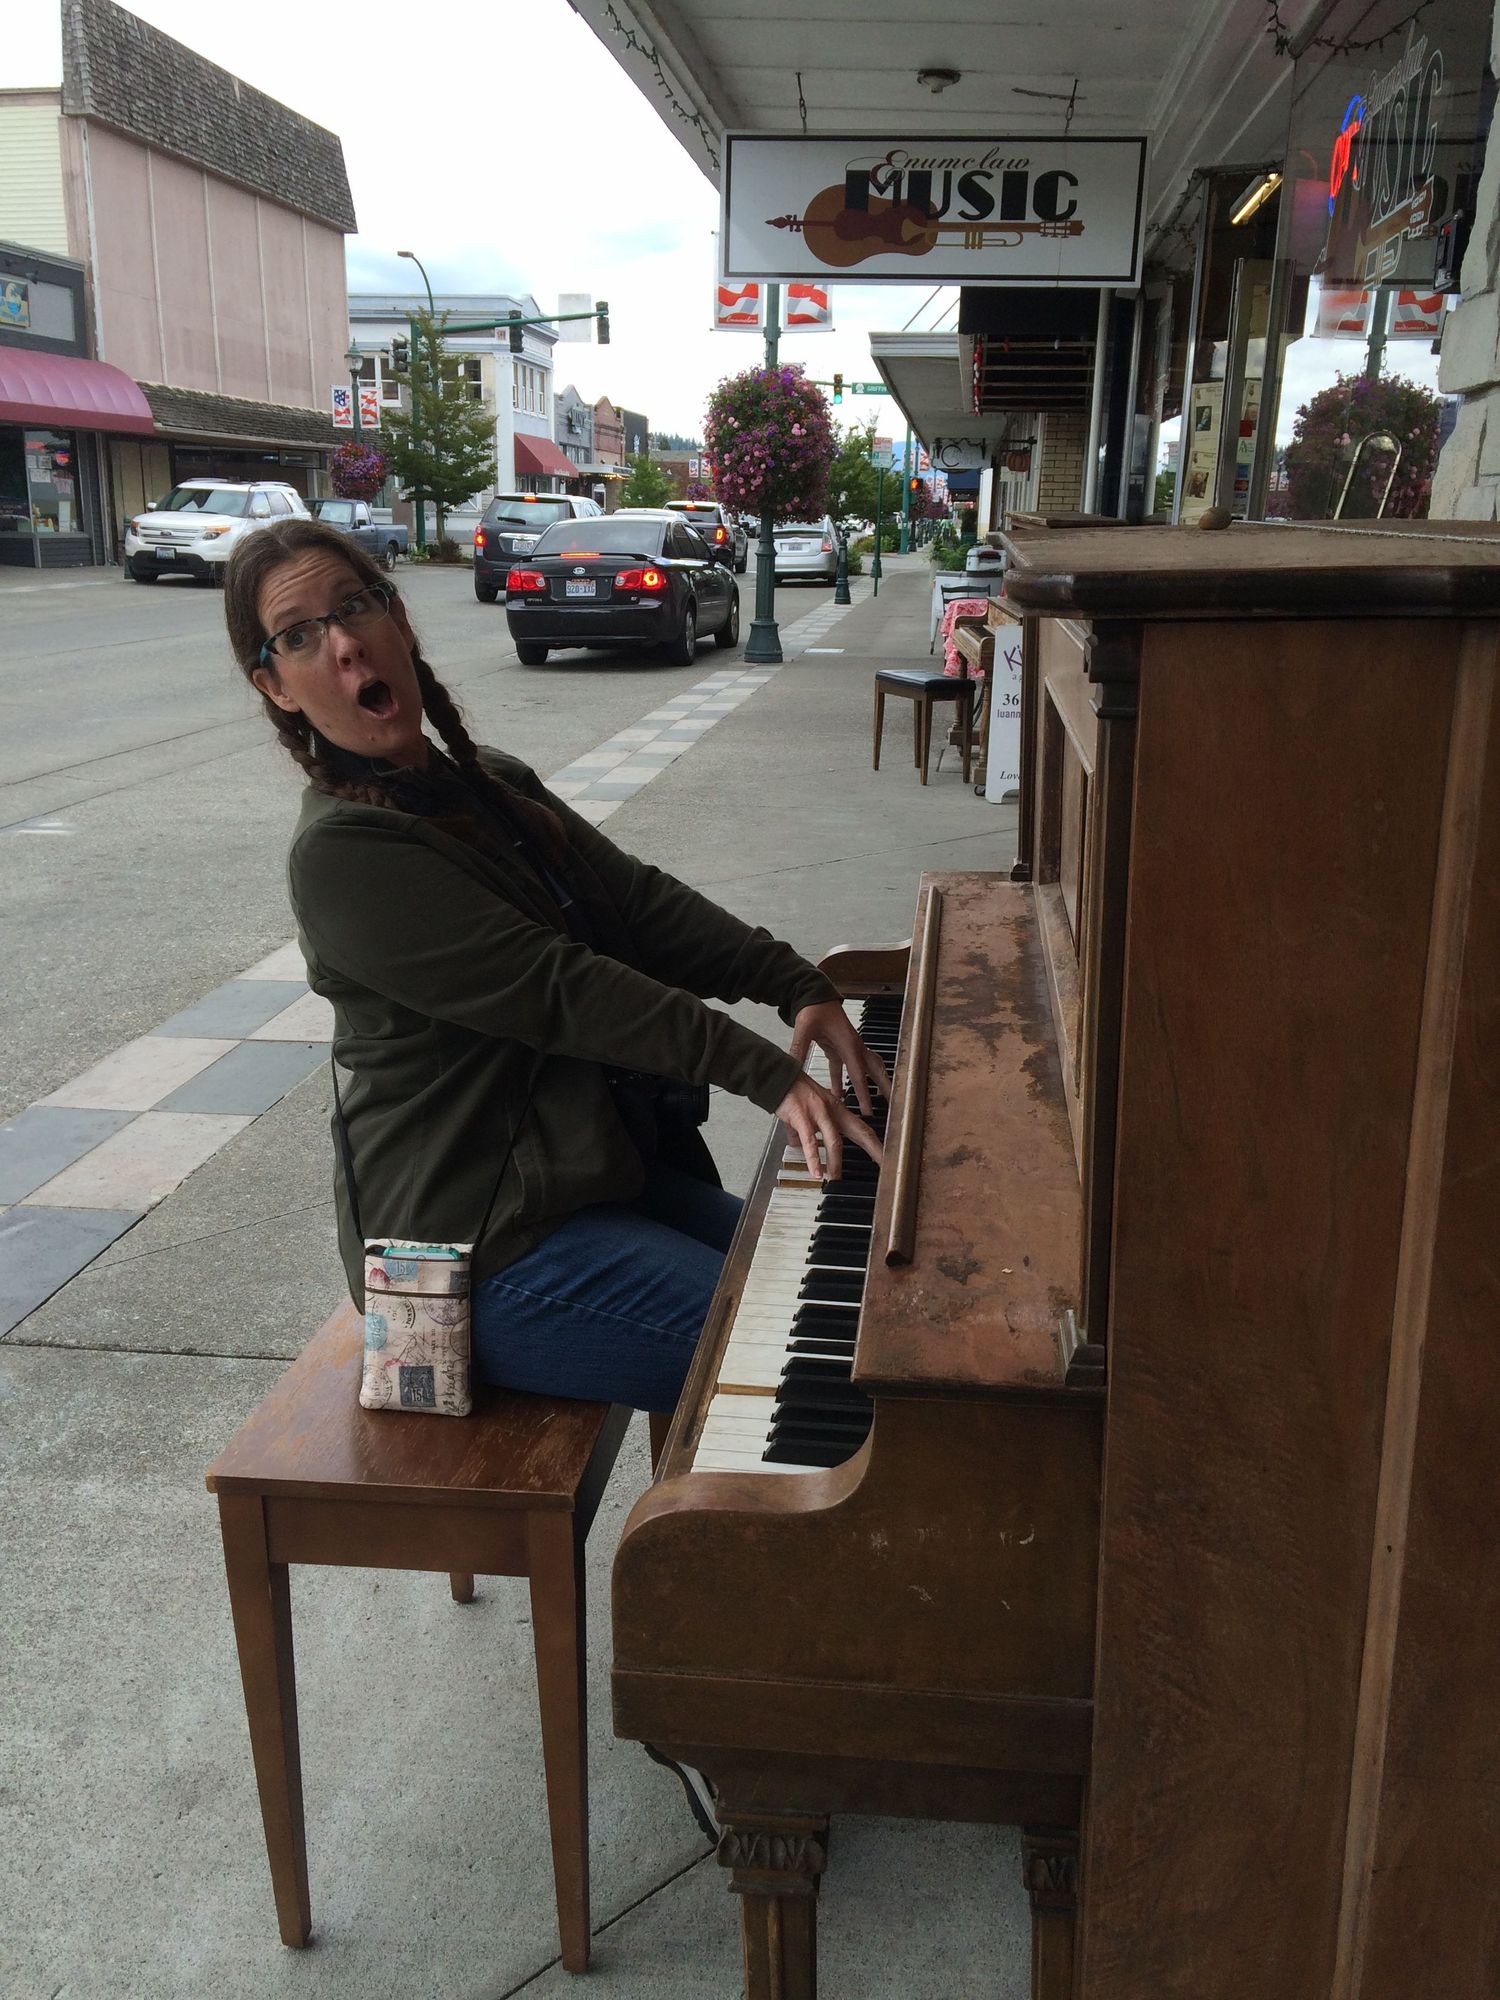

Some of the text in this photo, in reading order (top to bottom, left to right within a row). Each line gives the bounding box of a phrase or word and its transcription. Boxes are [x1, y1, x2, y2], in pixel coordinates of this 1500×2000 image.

[848, 147, 1032, 187] Enumclaw
[846, 170, 1079, 220] MUSIC
[1002, 693, 1020, 706] 36
